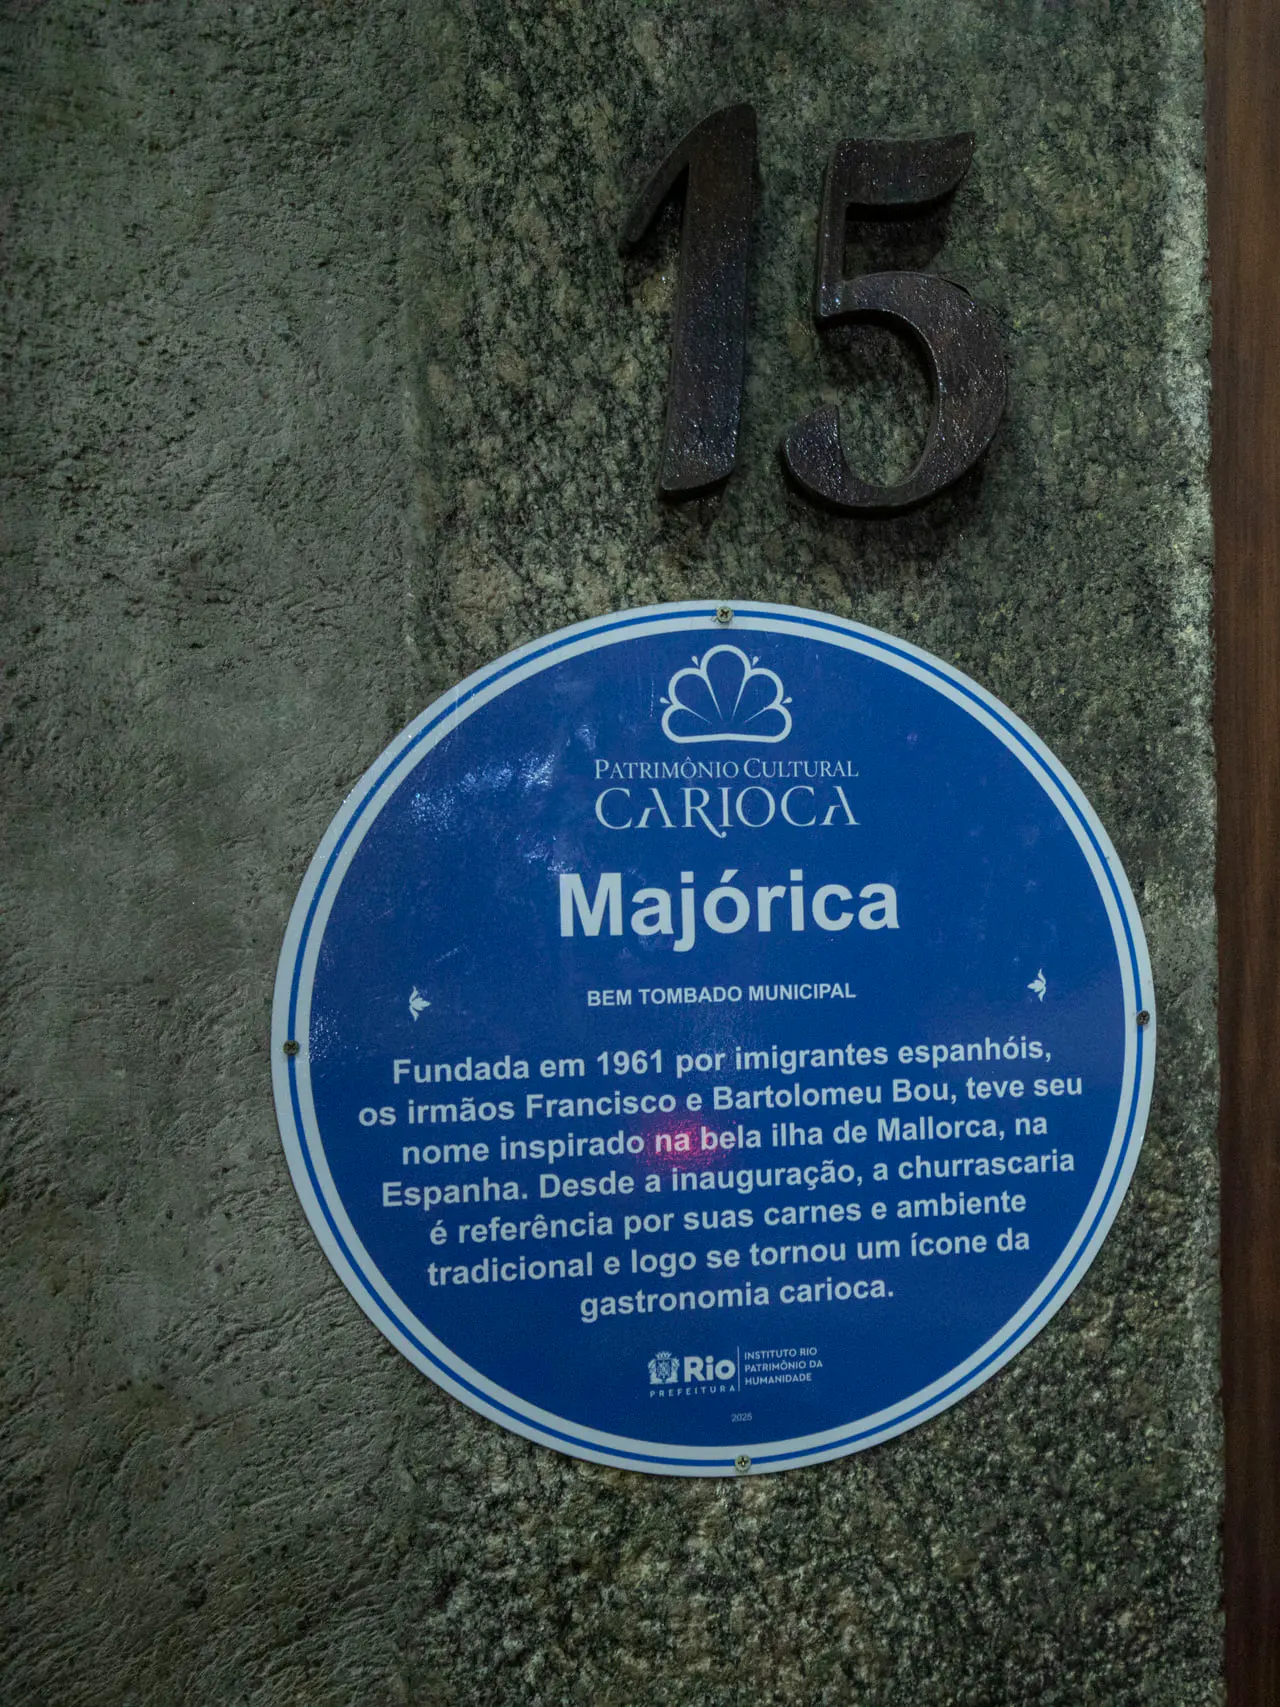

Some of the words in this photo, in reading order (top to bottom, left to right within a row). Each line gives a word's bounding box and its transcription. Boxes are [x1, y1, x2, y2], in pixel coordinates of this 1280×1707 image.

[624, 103, 1005, 510] 15
[595, 756, 740, 780] PATRIMÔNIO
[743, 757, 859, 779] CULTURAL
[594, 785, 860, 839] CARIOCA
[558, 868, 900, 953] Majórica
[587, 988, 632, 1007] BEM
[637, 985, 743, 1005] TOMBADO
[748, 982, 857, 1002] MUNICIPAL
[393, 1054, 530, 1085] Fundada
[539, 1058, 585, 1078] em
[596, 1048, 662, 1076] 1961
[676, 1052, 727, 1079] por
[735, 1043, 889, 1075] imigrantes
[897, 1035, 1052, 1069] espanhóis,
[358, 1106, 397, 1127] os
[408, 1096, 515, 1125] irmãos
[526, 1090, 677, 1119] Francisco
[686, 1092, 703, 1112] e
[713, 1082, 882, 1111] Bartolomeu
[892, 1078, 957, 1105] Bou,
[965, 1076, 1025, 1100] teve
[1033, 1077, 1083, 1097] seu
[402, 1142, 490, 1166] nome
[500, 1129, 645, 1165] inspirado
[655, 1132, 691, 1154] na
[700, 1124, 762, 1151] bela
[772, 1122, 824, 1147] ilha
[832, 1119, 868, 1145] de
[877, 1115, 1005, 1142] Mallorca,
[1015, 1116, 1048, 1136] na
[382, 1176, 528, 1212] Espanha.
[539, 1169, 635, 1199] Desde
[644, 1173, 661, 1193] a
[671, 1159, 863, 1195] inauguração,
[872, 1162, 889, 1182] a
[898, 1148, 1075, 1180] churrascaria
[429, 1219, 448, 1246] é
[458, 1213, 614, 1242] referência
[624, 1212, 675, 1241] por
[683, 1208, 754, 1231] suas
[763, 1202, 862, 1226] carnes
[871, 1201, 888, 1220] e
[896, 1190, 1027, 1219] ambiente
[427, 1251, 593, 1287] tradicional
[603, 1255, 621, 1276] e
[631, 1248, 697, 1278] logo
[706, 1248, 741, 1269] se
[749, 1242, 846, 1267] tornou
[856, 1239, 901, 1260] um
[911, 1231, 988, 1257] ícone
[996, 1227, 1030, 1252] da
[580, 1281, 770, 1324] gastronomia
[779, 1276, 894, 1304] carioca.
[683, 1355, 736, 1383] Rio
[744, 1348, 798, 1361] INSTITUTO
[799, 1346, 818, 1357] RIO
[744, 1359, 807, 1373] PATRIMÔNIO
[808, 1359, 824, 1369] DA
[649, 1384, 736, 1398] PREFEITURA
[744, 1372, 812, 1386] HUMANIDADE
[731, 1411, 753, 1423] 2025
